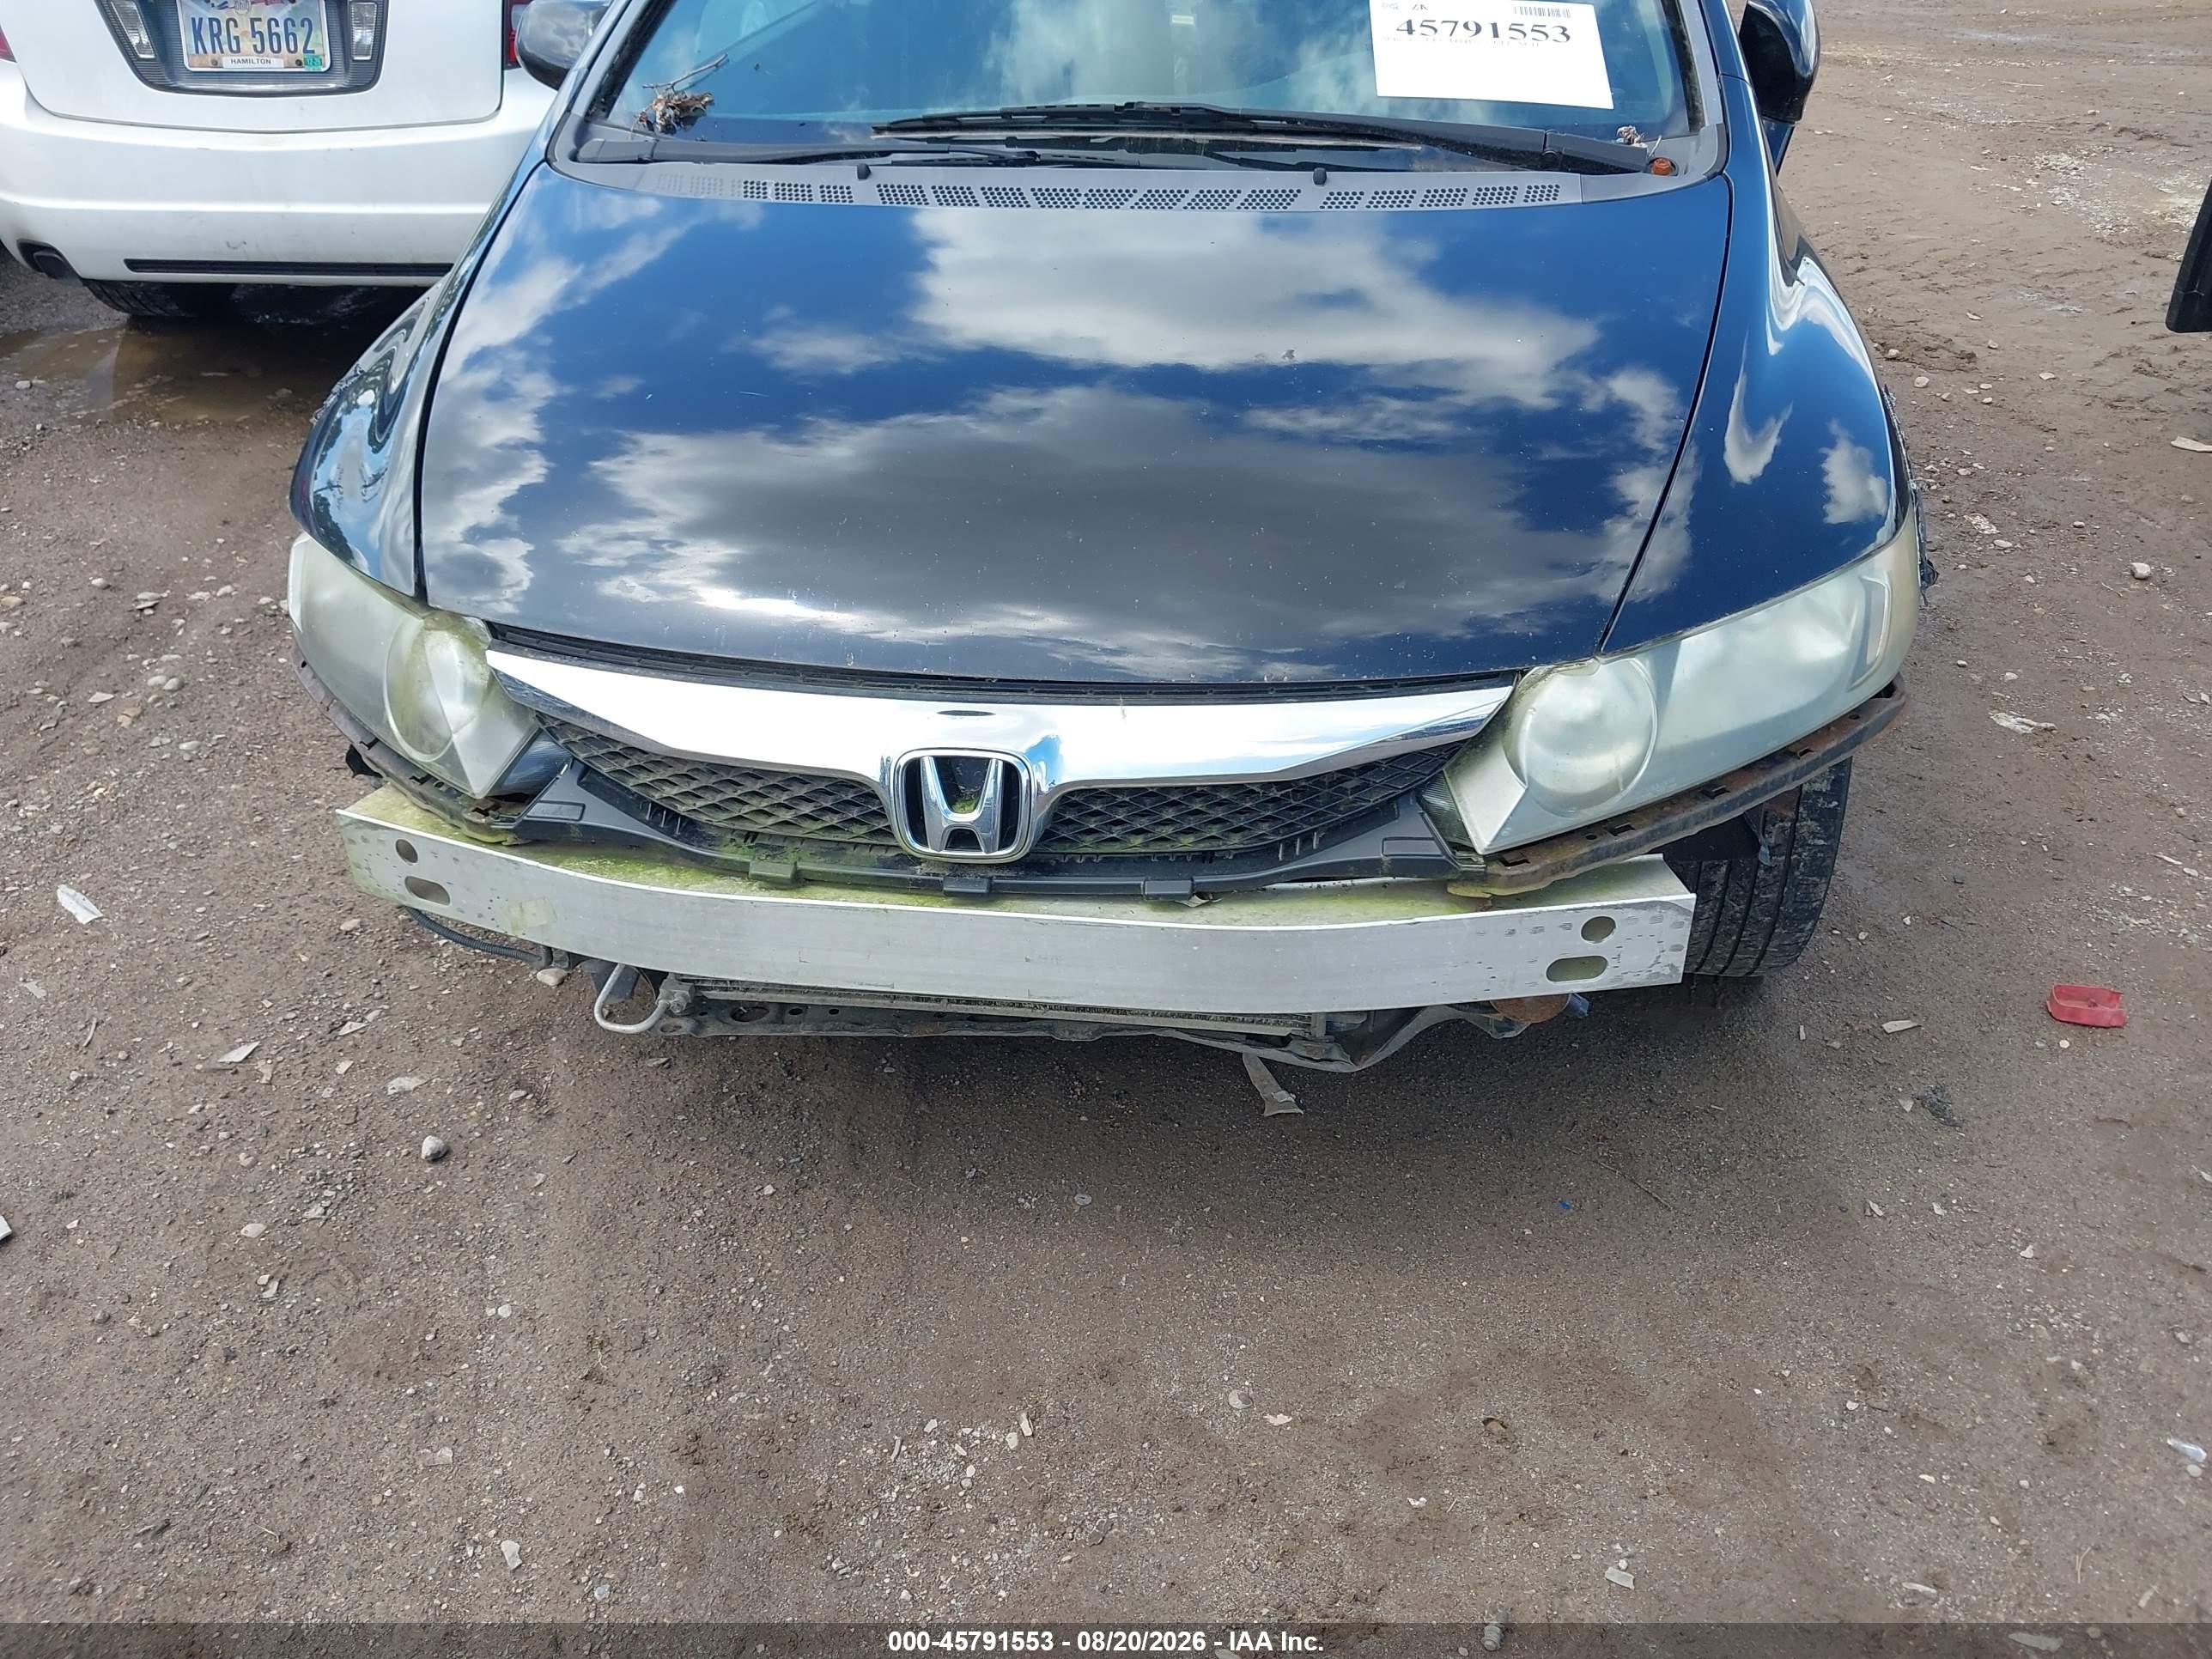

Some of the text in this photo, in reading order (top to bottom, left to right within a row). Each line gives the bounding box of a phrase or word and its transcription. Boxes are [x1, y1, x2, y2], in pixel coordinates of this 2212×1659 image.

[191, 16, 316, 55] KRG 5662
[1395, 18, 1571, 44] 45791553
